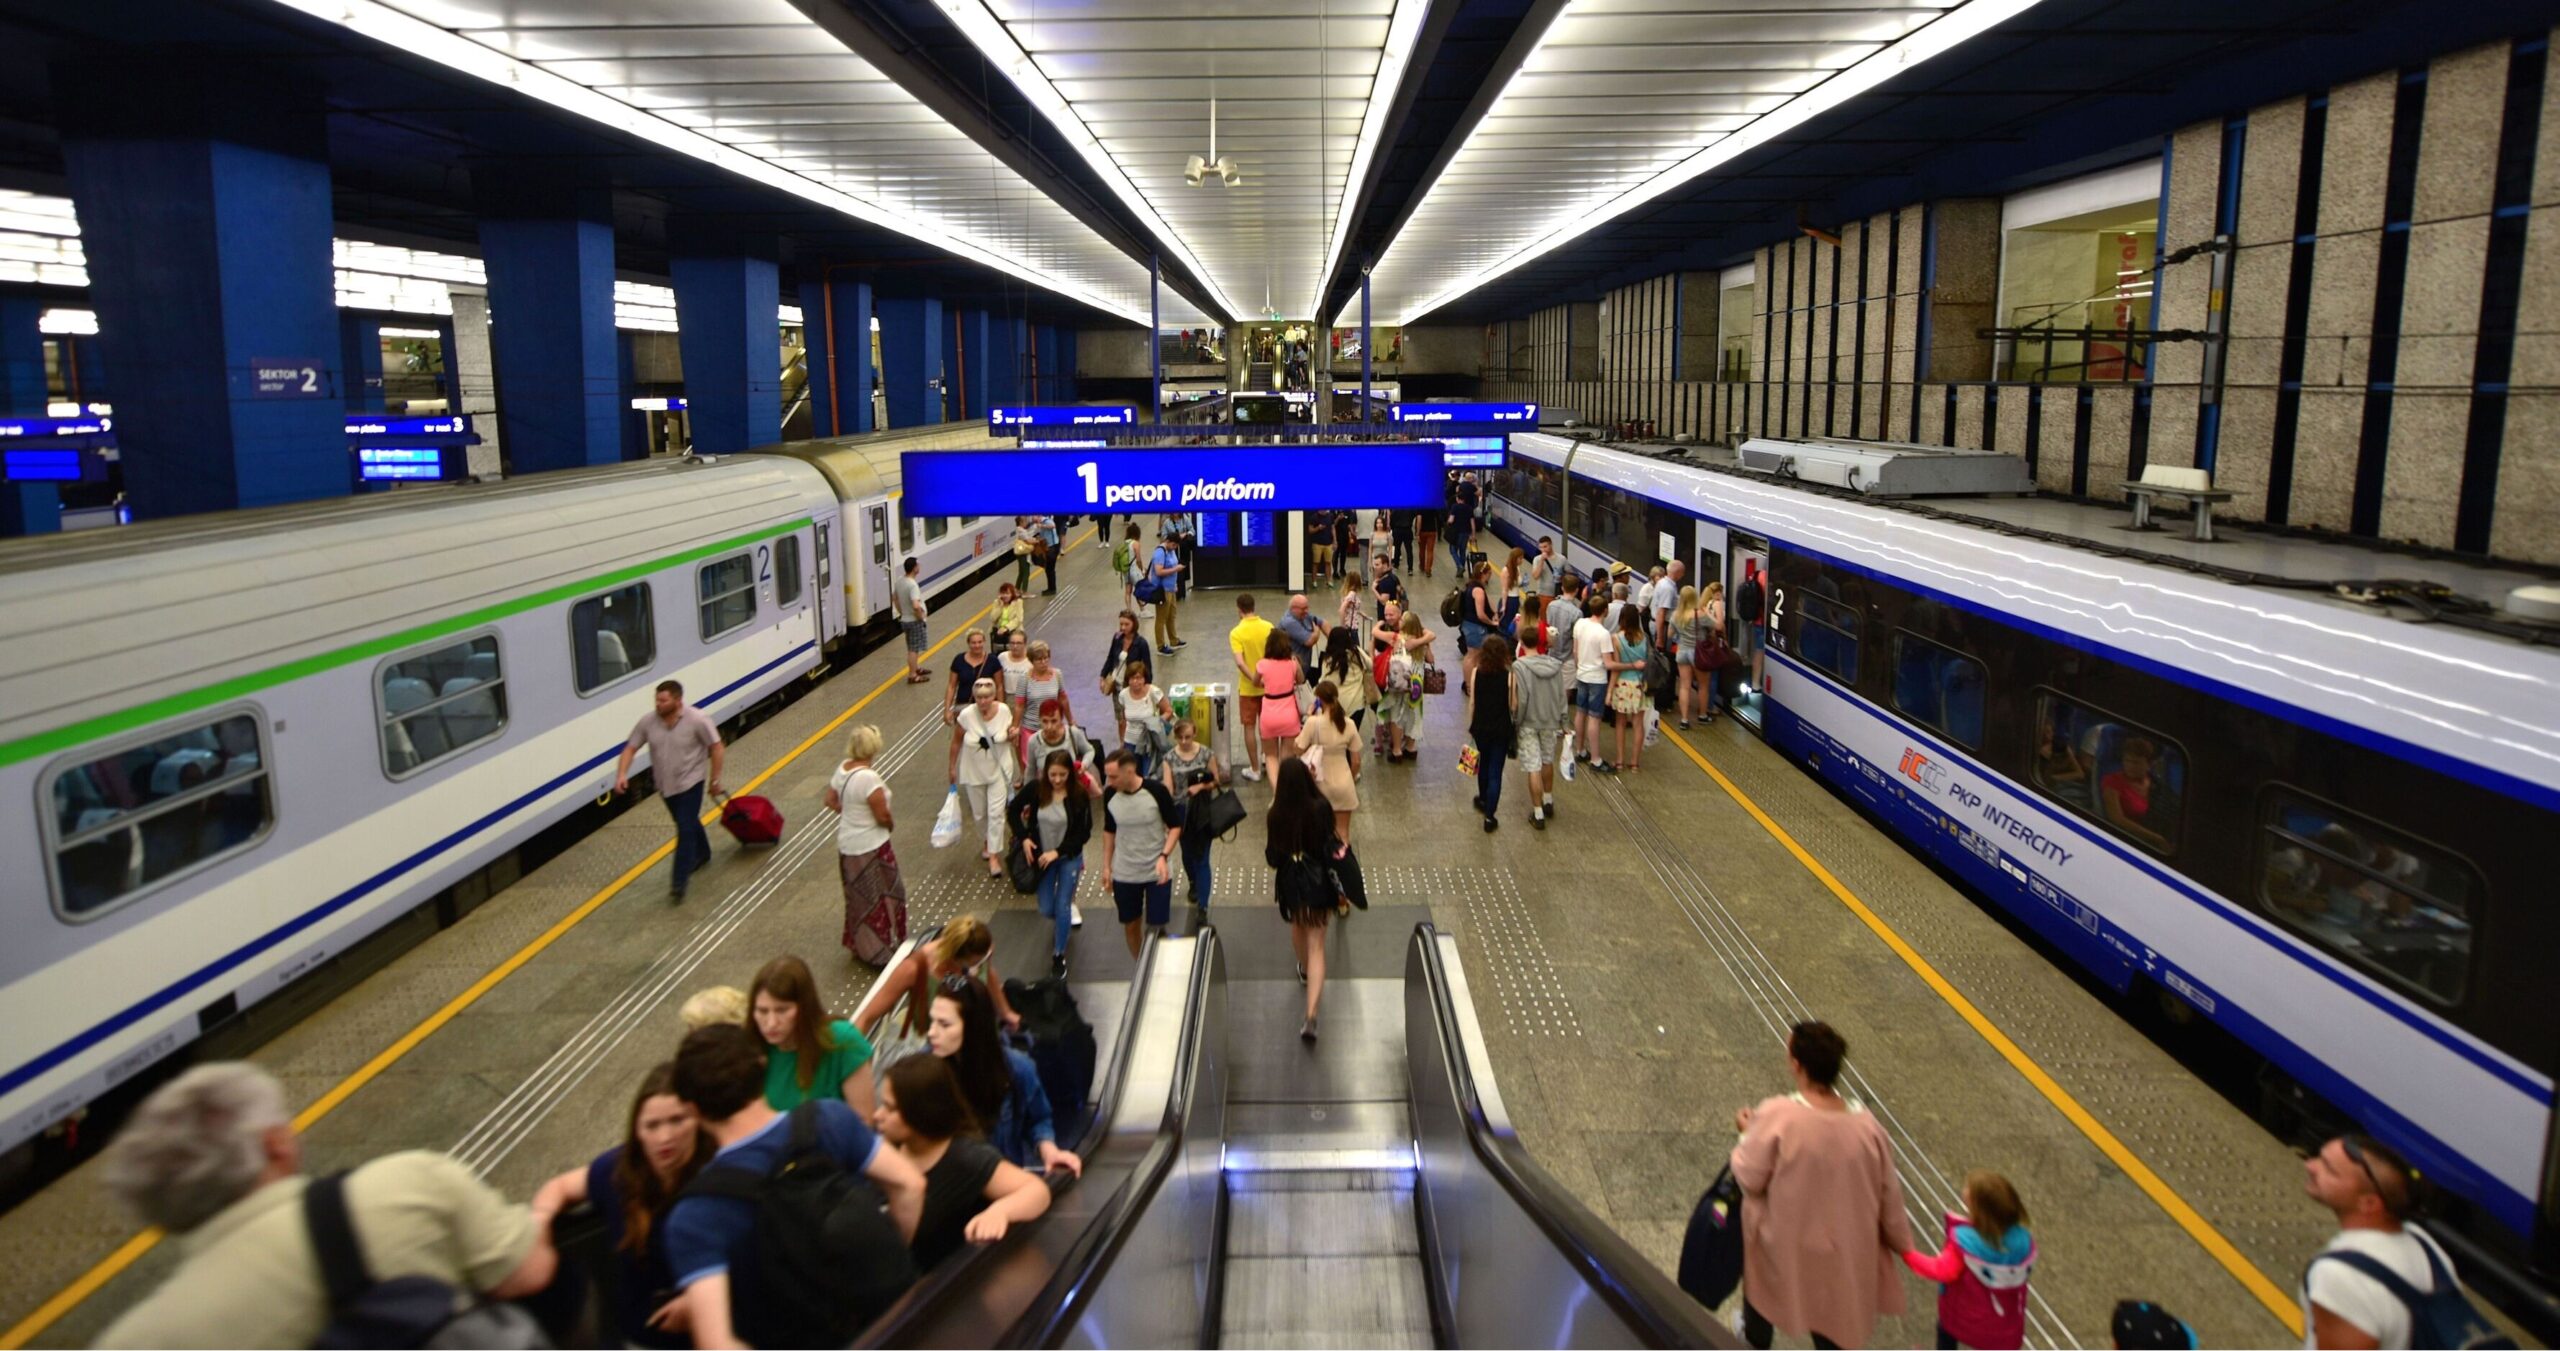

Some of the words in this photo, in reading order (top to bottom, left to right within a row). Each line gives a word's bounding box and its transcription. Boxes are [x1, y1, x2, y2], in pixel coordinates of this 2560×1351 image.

[259, 369, 298, 380] SEKTOR
[301, 367, 318, 392] 2
[453, 416, 464, 433] 3
[992, 409, 1003, 424] 5
[1123, 408, 1132, 423] 1
[1391, 406, 1400, 420] 1
[1525, 404, 1536, 420] 7
[1076, 461, 1099, 503] 1
[1105, 484, 1172, 507] peron
[1180, 476, 1275, 506] platform
[758, 544, 771, 583] 2
[1774, 588, 1785, 616] 2
[1948, 782, 1982, 809] PKP
[1982, 803, 2073, 867] INTERCITY
